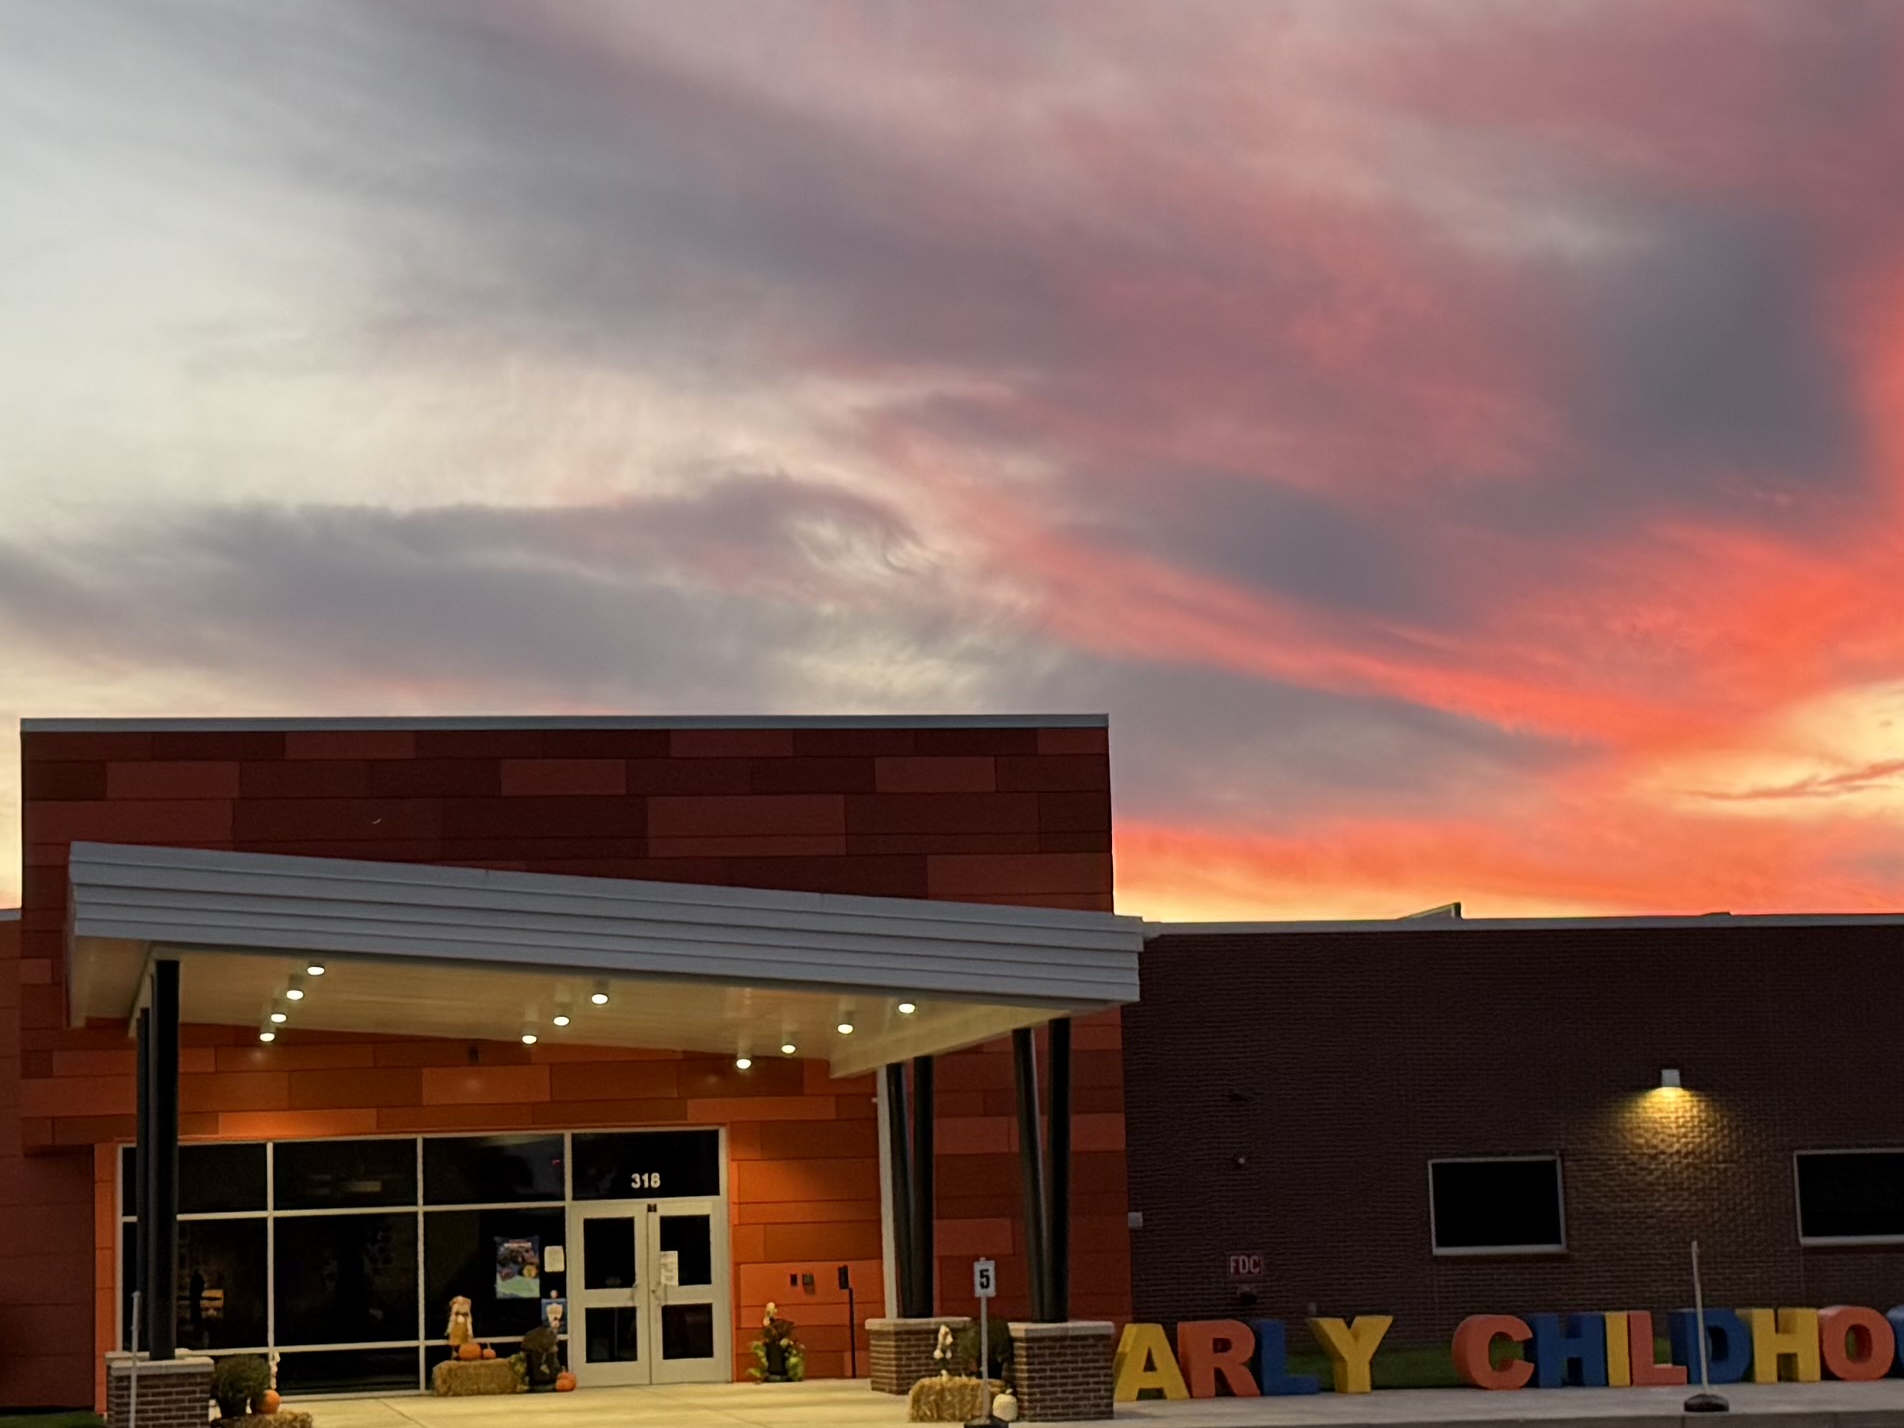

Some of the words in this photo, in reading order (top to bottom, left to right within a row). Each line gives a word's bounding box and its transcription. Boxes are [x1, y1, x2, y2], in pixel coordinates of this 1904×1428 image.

[631, 1172, 661, 1189] 318
[1230, 1255, 1260, 1273] FDC
[979, 1268, 990, 1289] 5
[1113, 1315, 1394, 1402] ARLY
